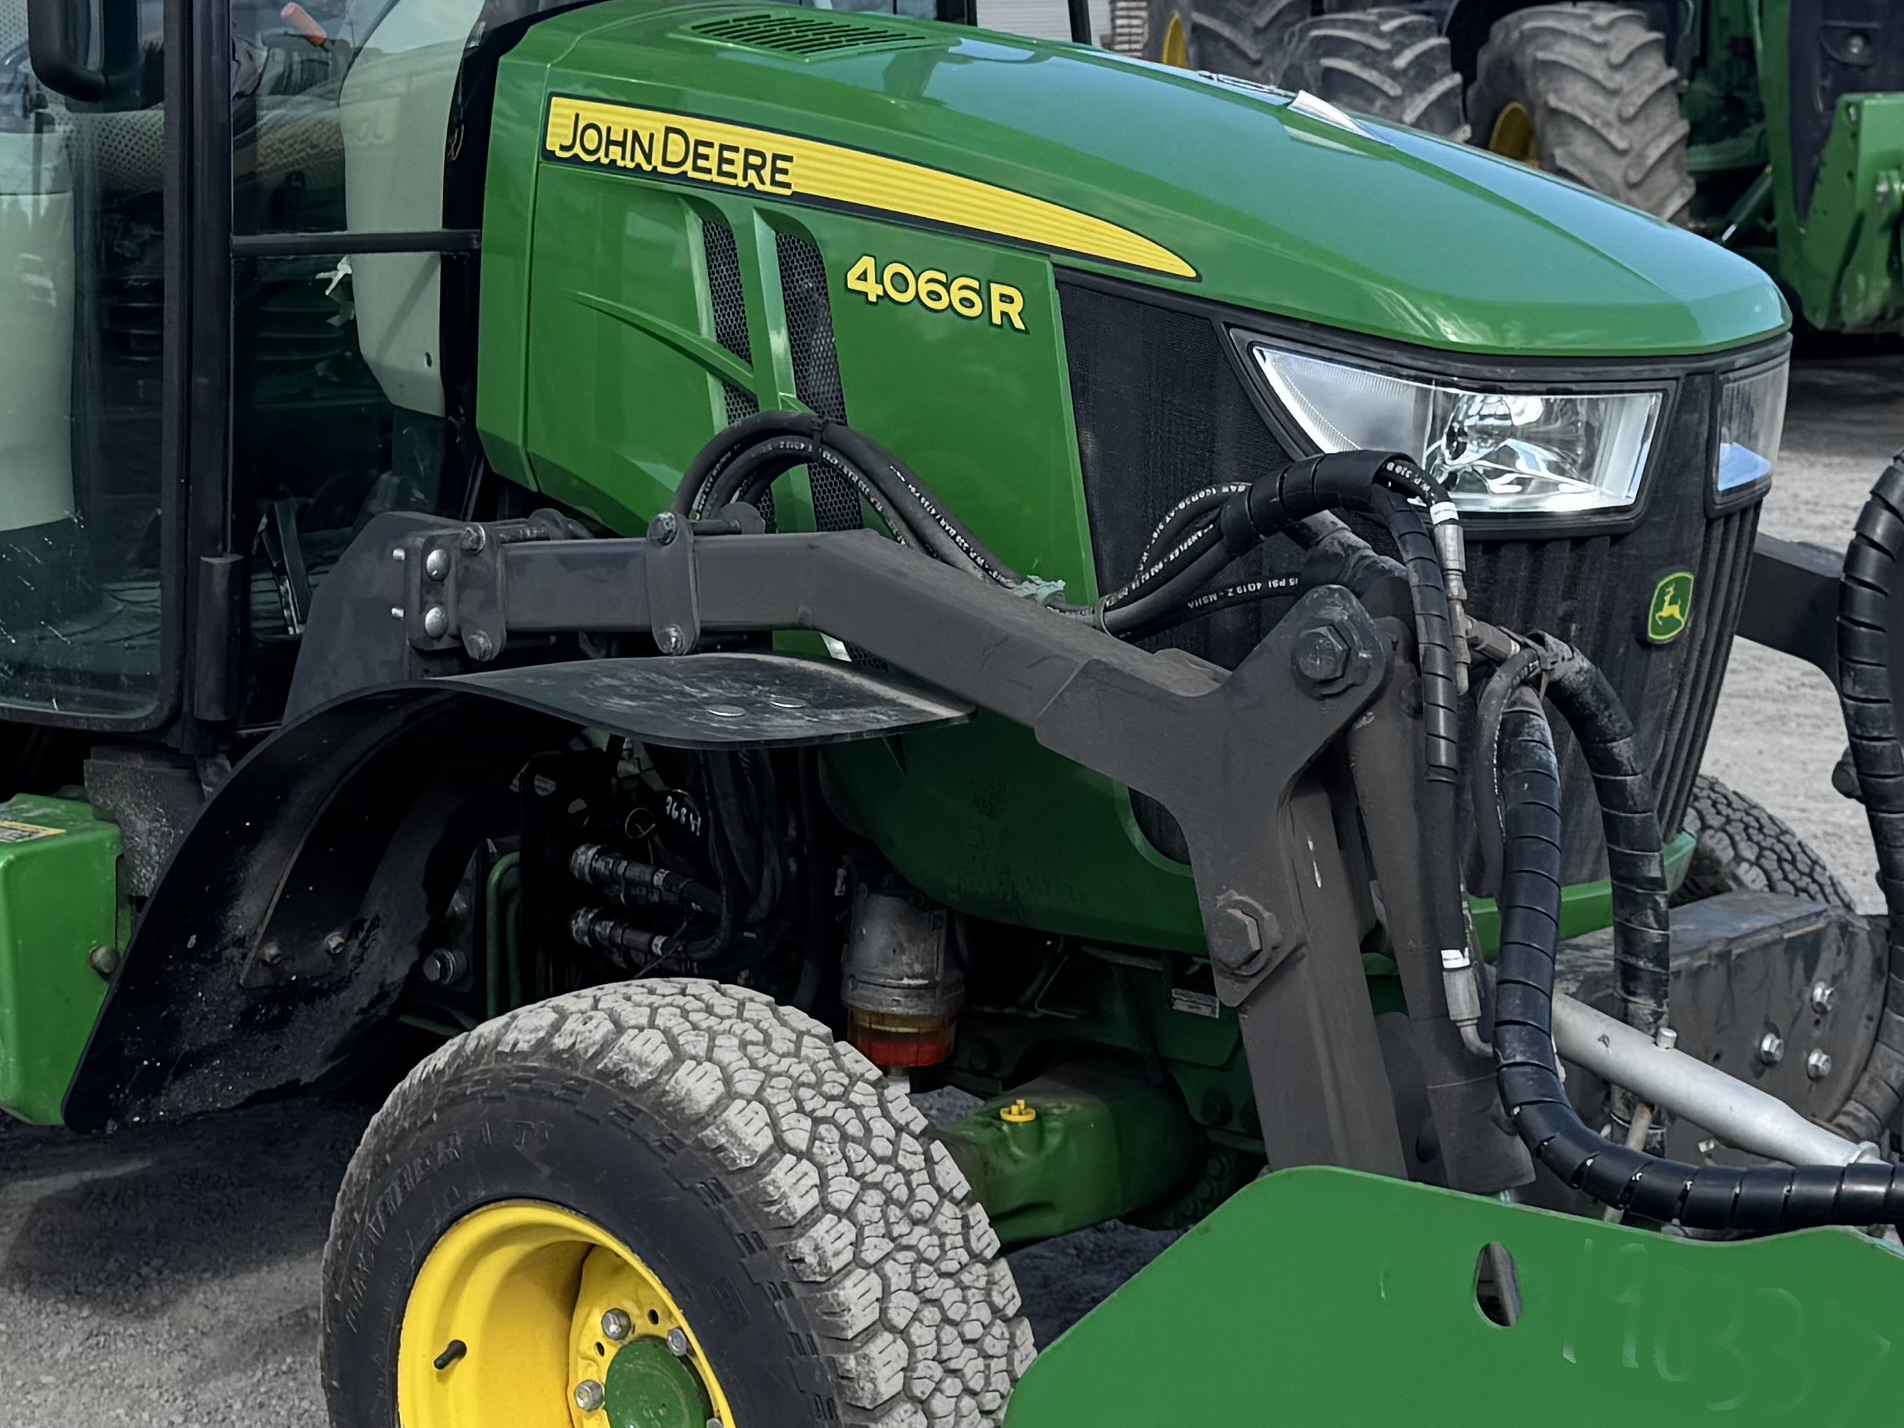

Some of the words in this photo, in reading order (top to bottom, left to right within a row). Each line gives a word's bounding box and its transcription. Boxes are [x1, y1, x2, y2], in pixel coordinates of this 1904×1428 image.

[559, 112, 655, 166] JOHN
[661, 125, 794, 190] DEERE
[1268, 579, 1286, 589] PSI
